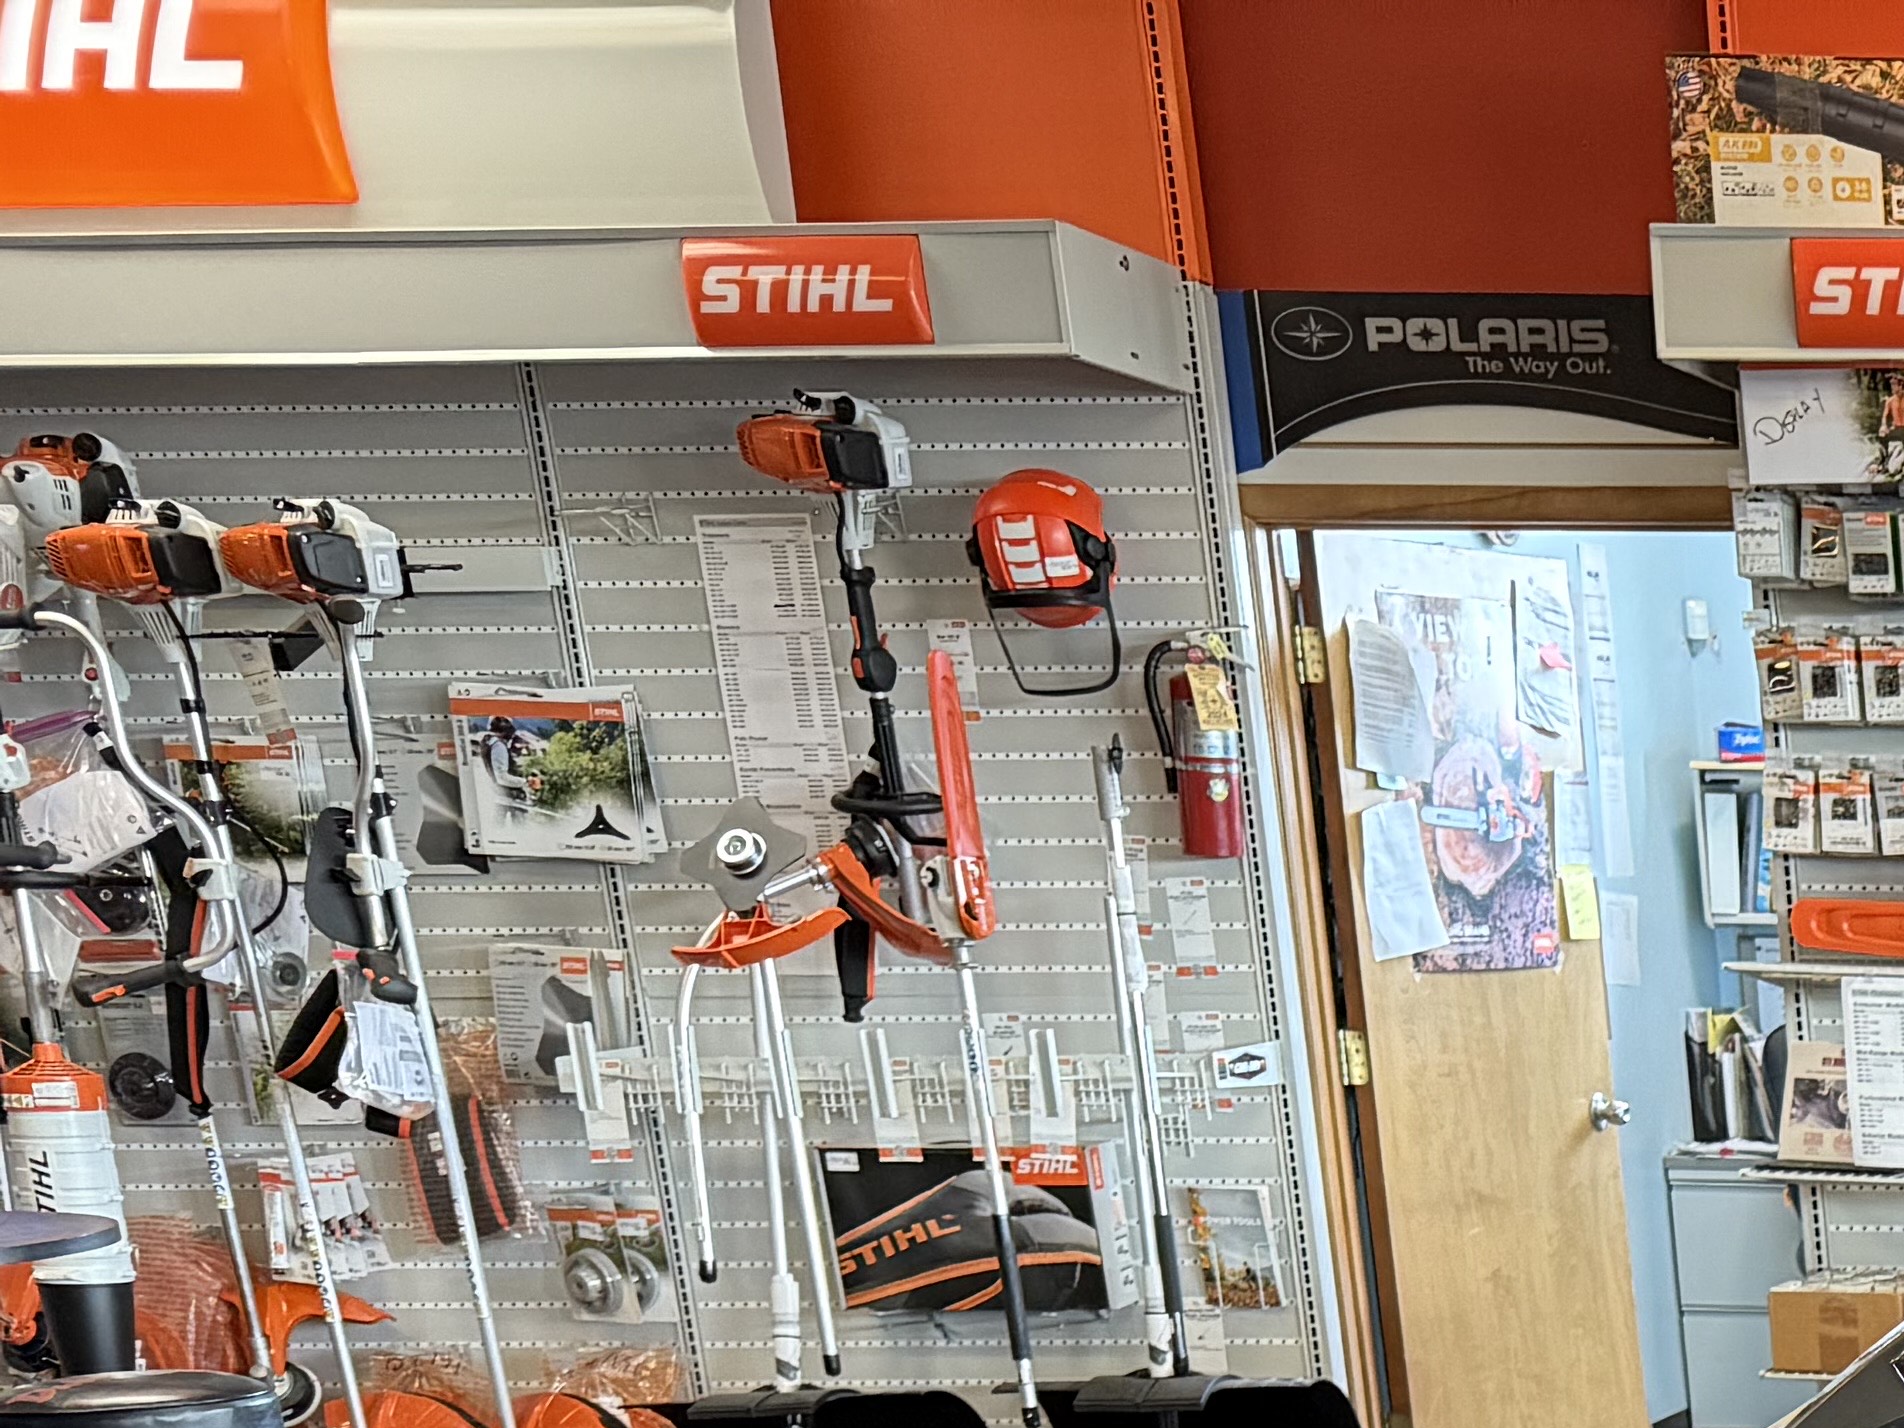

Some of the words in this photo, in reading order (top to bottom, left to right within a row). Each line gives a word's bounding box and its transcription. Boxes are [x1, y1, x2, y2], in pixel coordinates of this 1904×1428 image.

[0, 0, 243, 89] IHL
[700, 264, 893, 313] STIHL
[1364, 317, 1608, 354] POLARIS
[1464, 356, 1504, 374] The
[1510, 357, 1558, 380] Way
[28, 1150, 57, 1212] TIHL
[838, 1217, 963, 1277] STIHL
